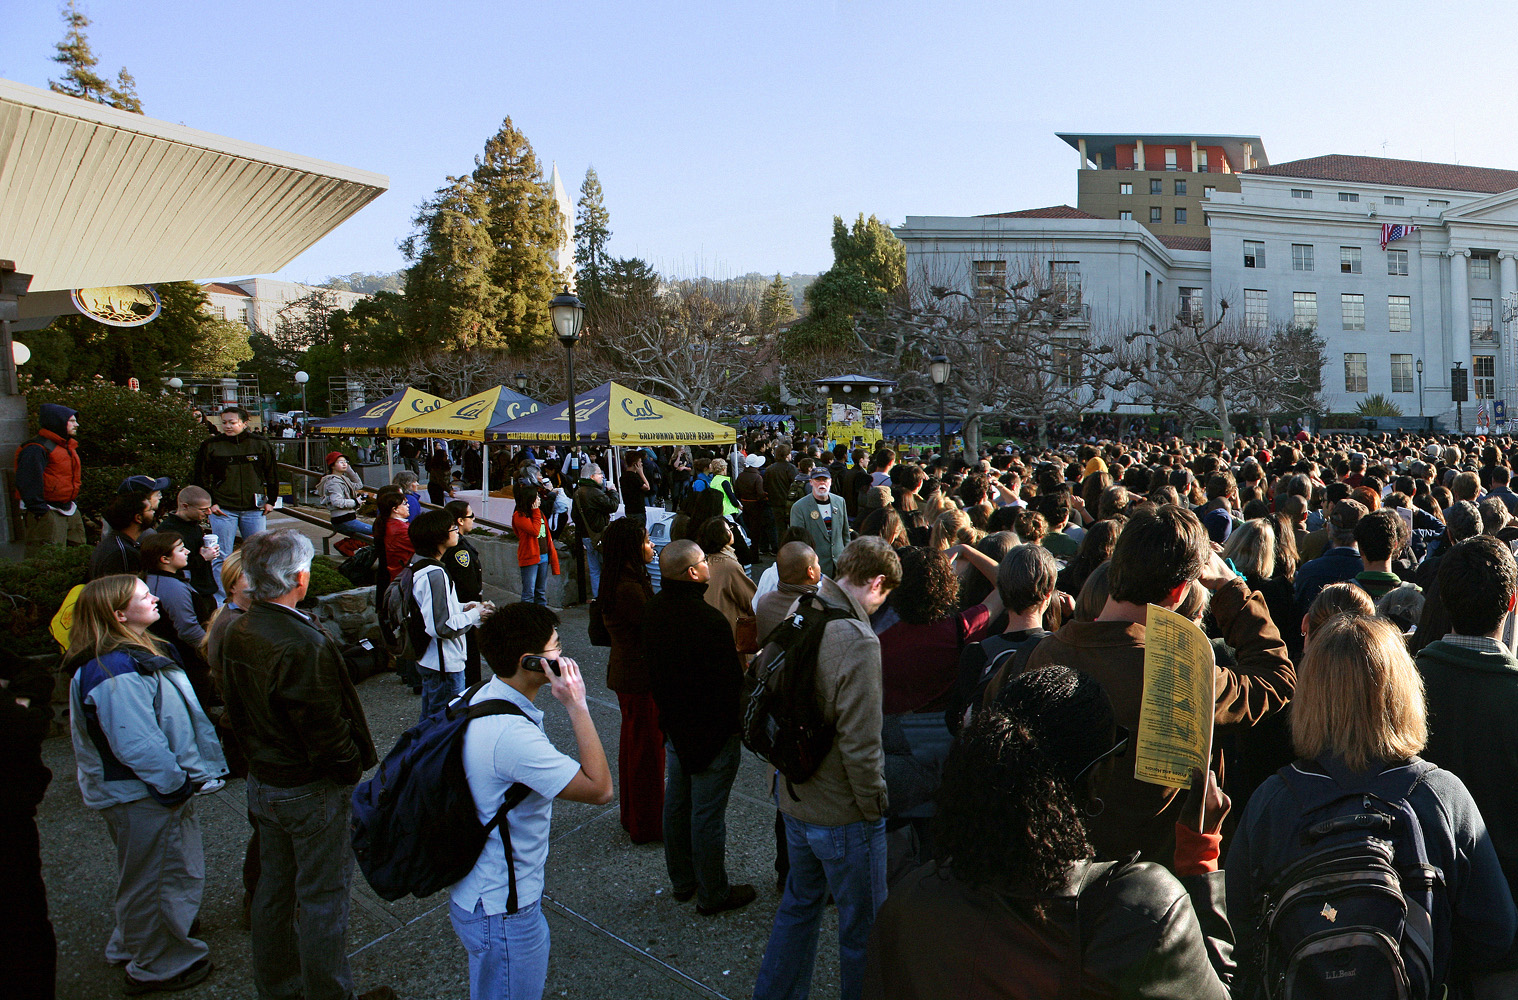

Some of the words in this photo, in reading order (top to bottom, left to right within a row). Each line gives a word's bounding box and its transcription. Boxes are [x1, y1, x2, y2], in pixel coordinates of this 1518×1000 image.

[359, 400, 400, 419] Cal
[411, 399, 441, 414] Cal
[450, 400, 493, 420] Cal
[621, 398, 663, 421] Cal
[638, 432, 675, 440] CALIFORNIA
[675, 432, 697, 440] GOLDEN
[698, 432, 715, 440] BEARS
